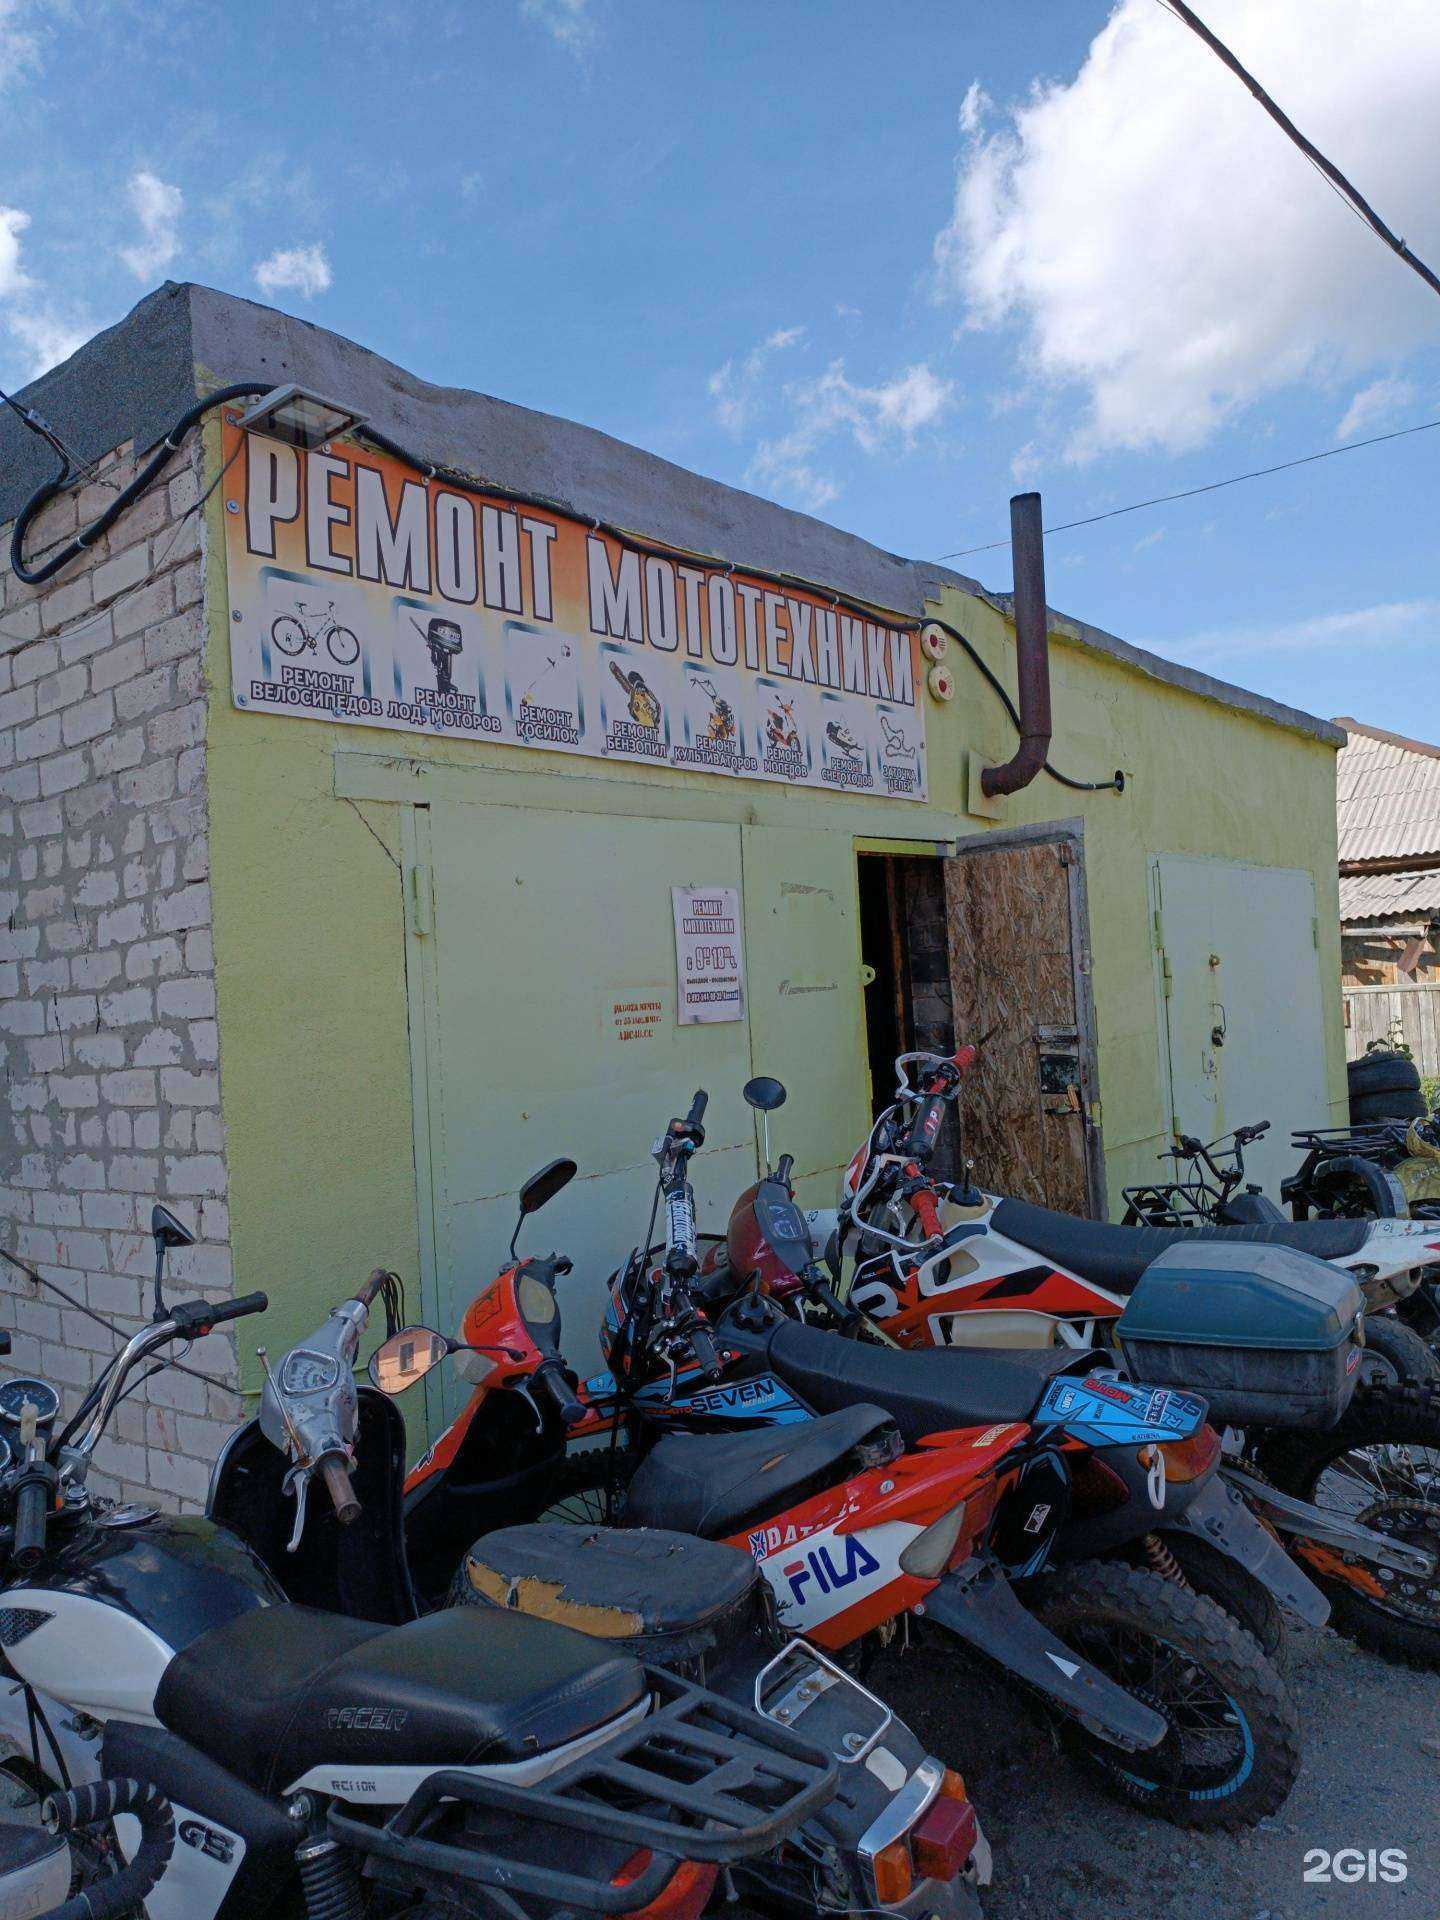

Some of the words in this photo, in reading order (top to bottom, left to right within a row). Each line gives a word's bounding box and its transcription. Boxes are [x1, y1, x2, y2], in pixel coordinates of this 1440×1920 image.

[246, 431, 558, 623] РЕМОНТ
[586, 534, 916, 707] МОТОТЕХНИКИ
[281, 665, 355, 694] РЕМОНТ
[251, 680, 384, 717] ВЕЛОСИПЕДОВ
[414, 686, 476, 713] РЕМОНТ
[387, 700, 428, 726] ЛОД.
[431, 707, 502, 733] МОТОРОВ
[519, 704, 573, 728] РЕМОНТ
[515, 720, 579, 746] КОСИЛОК
[612, 720, 660, 743] РЕМОНТ
[605, 735, 668, 759] БЕНЗОПИЛ
[695, 734, 737, 756] РЕМОНТ
[766, 746, 804, 764] РЕМОНТ
[673, 746, 759, 772] КУЛЬТИВАТОРОВ
[763, 759, 809, 779] МОПЕДОВ
[830, 757, 864, 774] РЕМОНТ
[820, 768, 874, 788] СНЕГОХОДОВ
[882, 764, 917, 782] ЗАТОЧКА
[692, 899, 723, 916] РЕМОНТ
[683, 918, 735, 935] МОТОТЕХНИКИ
[690, 1378, 776, 1413] SEVEN
[782, 1534, 880, 1606] FILA
[327, 1706, 409, 1732] RACER
